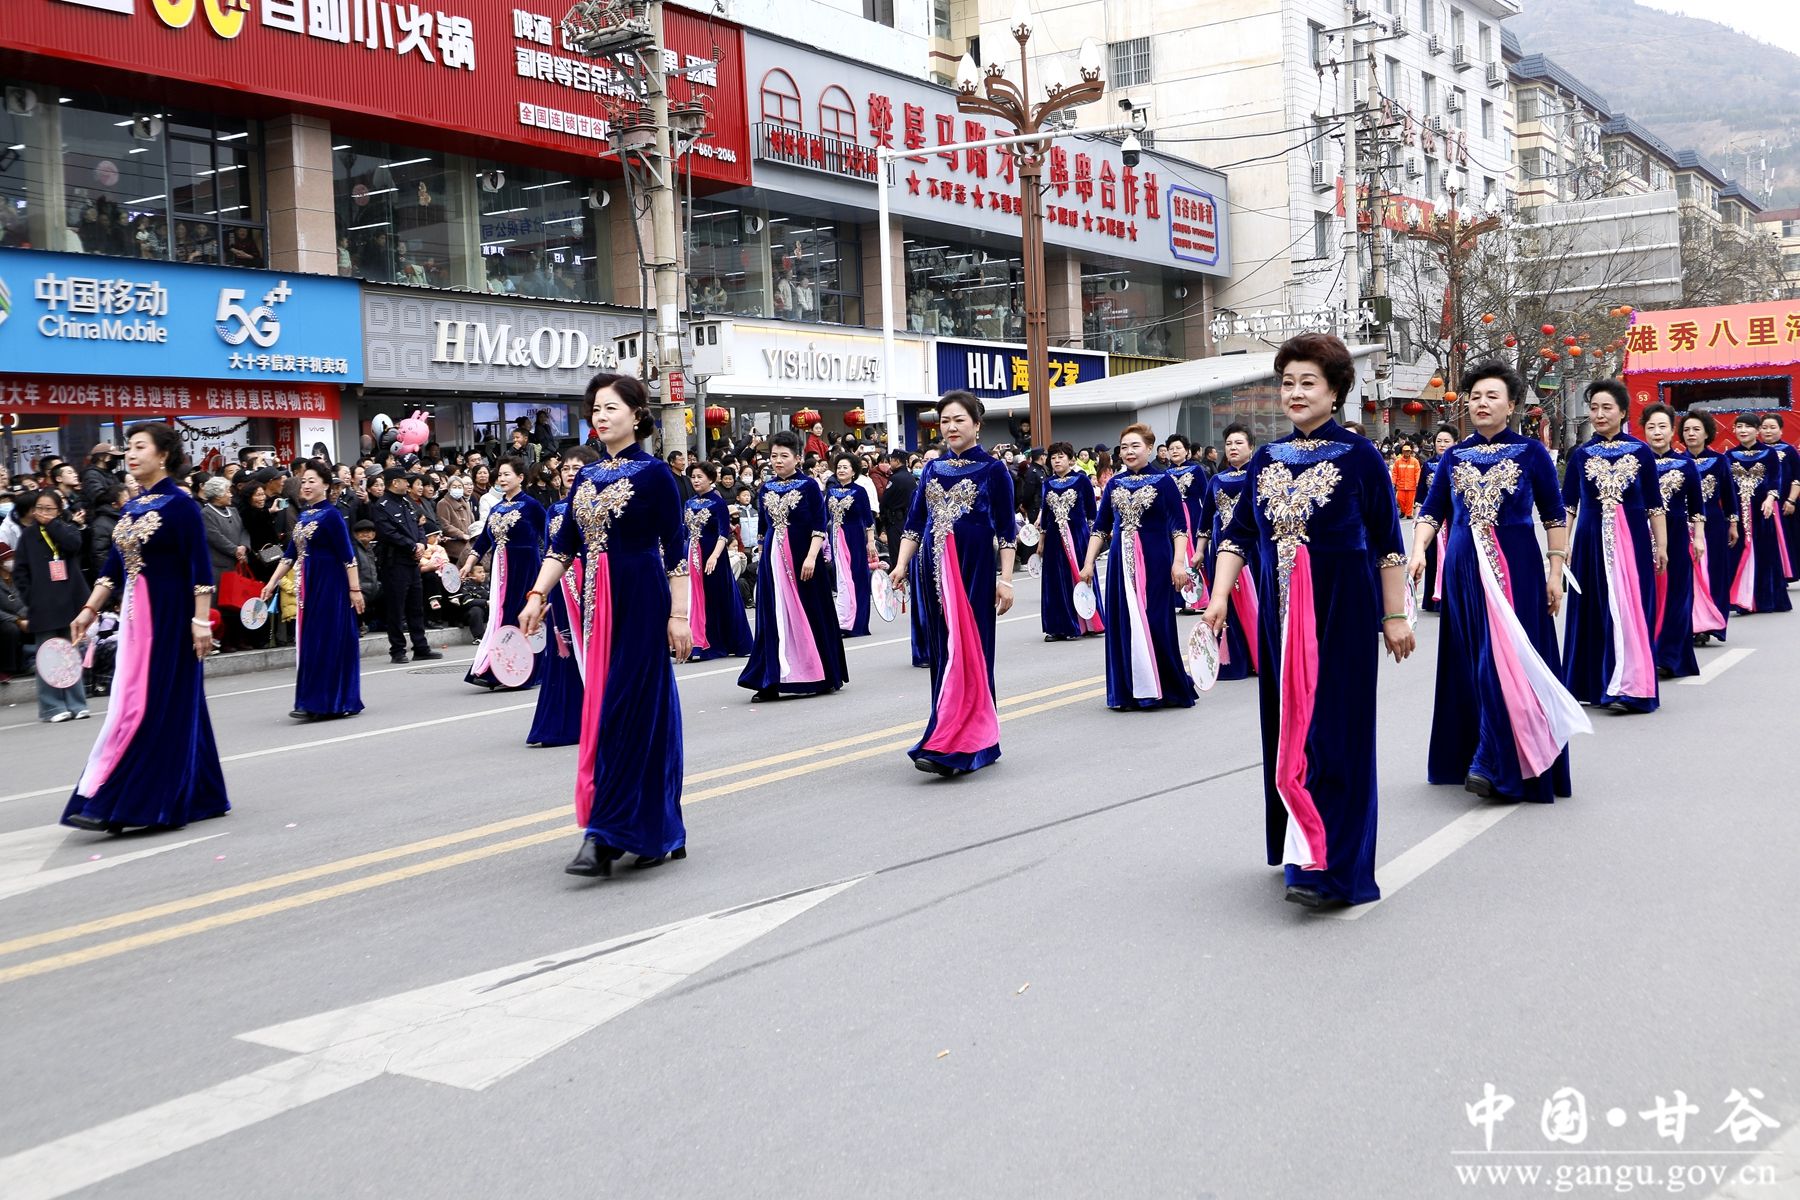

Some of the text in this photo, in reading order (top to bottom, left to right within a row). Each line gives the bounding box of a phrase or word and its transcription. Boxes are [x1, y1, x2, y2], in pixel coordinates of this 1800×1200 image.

[513, 9, 553, 46] 啤酒
[521, 105, 611, 137] 全国连锁甘谷
[34, 273, 168, 317] 中国移动
[229, 352, 348, 375] 大十字信发手机卖场
[432, 320, 588, 370] HM&OD
[967, 352, 1079, 391] HLA 海之家
[1638, 394, 1648, 402] 53
